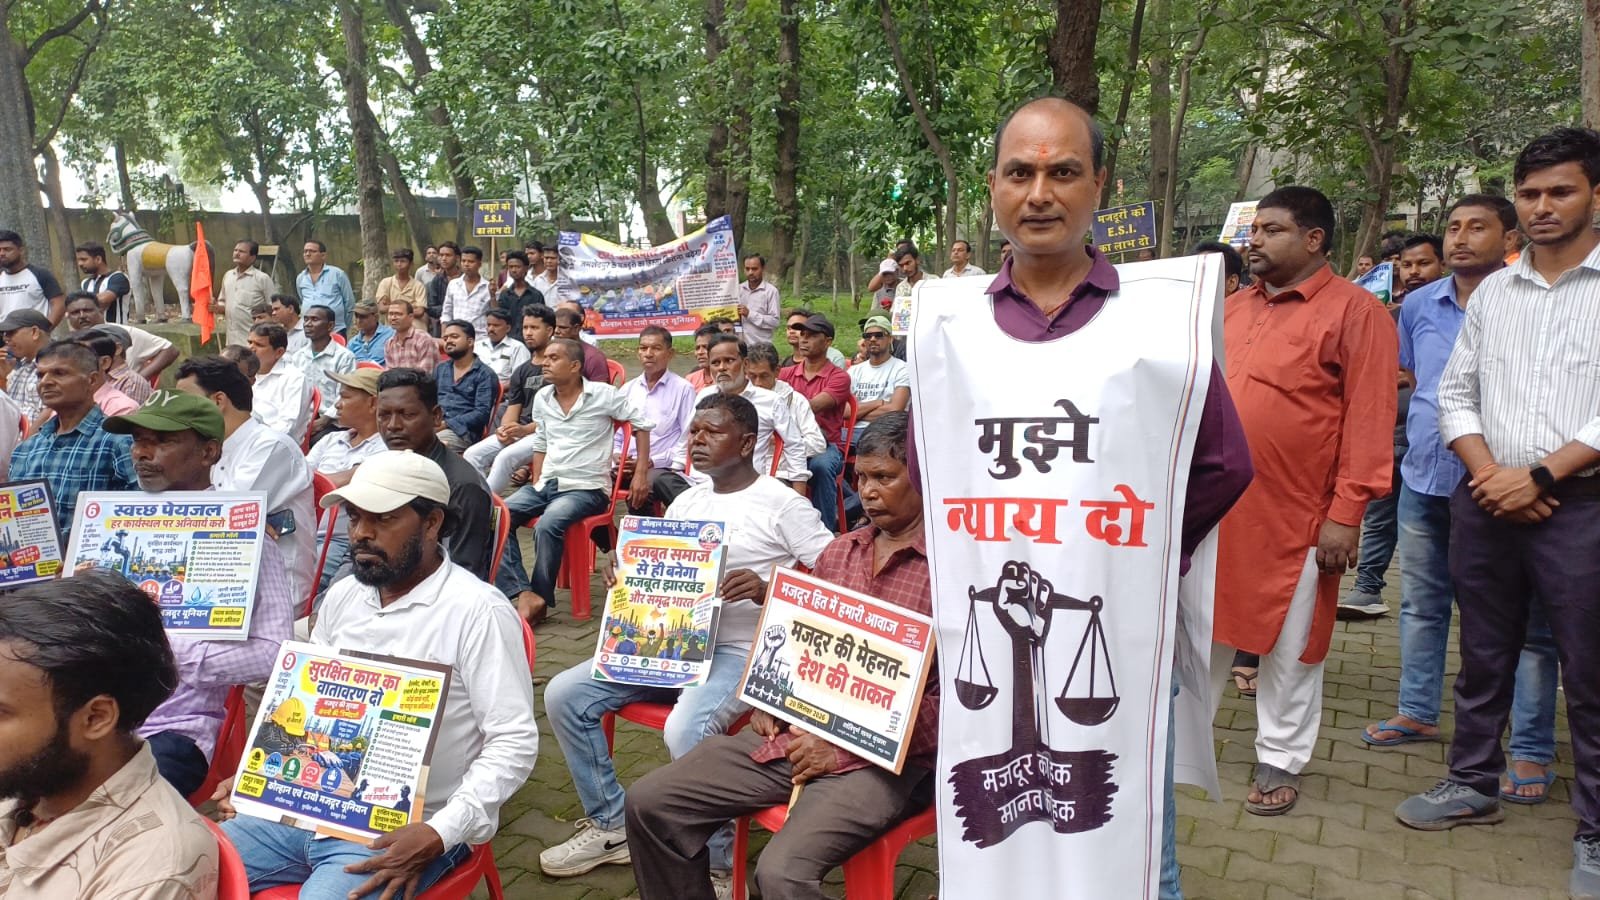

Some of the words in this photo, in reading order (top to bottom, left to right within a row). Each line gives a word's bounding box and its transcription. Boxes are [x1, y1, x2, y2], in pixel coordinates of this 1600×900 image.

[1131, 205, 1146, 217] को
[1107, 223, 1137, 237] E.S.I.
[1114, 239, 1136, 250] लाभ
[1138, 234, 1150, 246] दो
[975, 399, 1099, 480] मुझे
[114, 504, 159, 517] स्वच्छ
[162, 501, 224, 517] पेयजल
[943, 497, 1068, 544] न्याय
[1080, 484, 1155, 547] दो
[111, 520, 121, 529] हर
[123, 517, 161, 529] कार्यस्थल
[162, 520, 173, 528] पर
[175, 517, 208, 528] अनिवार्य
[209, 517, 226, 528] करो
[629, 546, 668, 563] मजबूत
[670, 548, 712, 563] समाज
[636, 559, 650, 576] से
[651, 562, 665, 577] ही
[666, 563, 699, 579] बनेगा
[624, 576, 662, 593] मजबूत
[662, 577, 706, 594] झारखंड
[629, 589, 645, 603] और
[646, 593, 671, 609] समृद्ध
[672, 595, 696, 608] भारत
[781, 581, 811, 607] मजदूर
[812, 588, 829, 610] हित
[829, 593, 839, 613] में
[839, 601, 865, 624] हमारी
[865, 614, 899, 637] आवाज
[182, 607, 209, 619] यूनियन
[791, 620, 834, 656] मजदूर
[835, 631, 856, 662] की
[309, 659, 353, 682] सुरक्षित
[353, 669, 382, 688] काम
[382, 674, 402, 691] का
[797, 649, 826, 684] देश
[826, 662, 850, 694] की
[850, 676, 896, 711] ताकत
[317, 680, 369, 703] वातावरण
[369, 687, 384, 707] दो
[981, 754, 1034, 792] मजदूर
[267, 780, 290, 794] कोल्हान
[292, 787, 303, 797] एवं
[303, 791, 319, 802] टायो
[319, 796, 341, 810] मजदूर
[341, 799, 368, 815] यूनियन
[997, 789, 1043, 824] मानव
